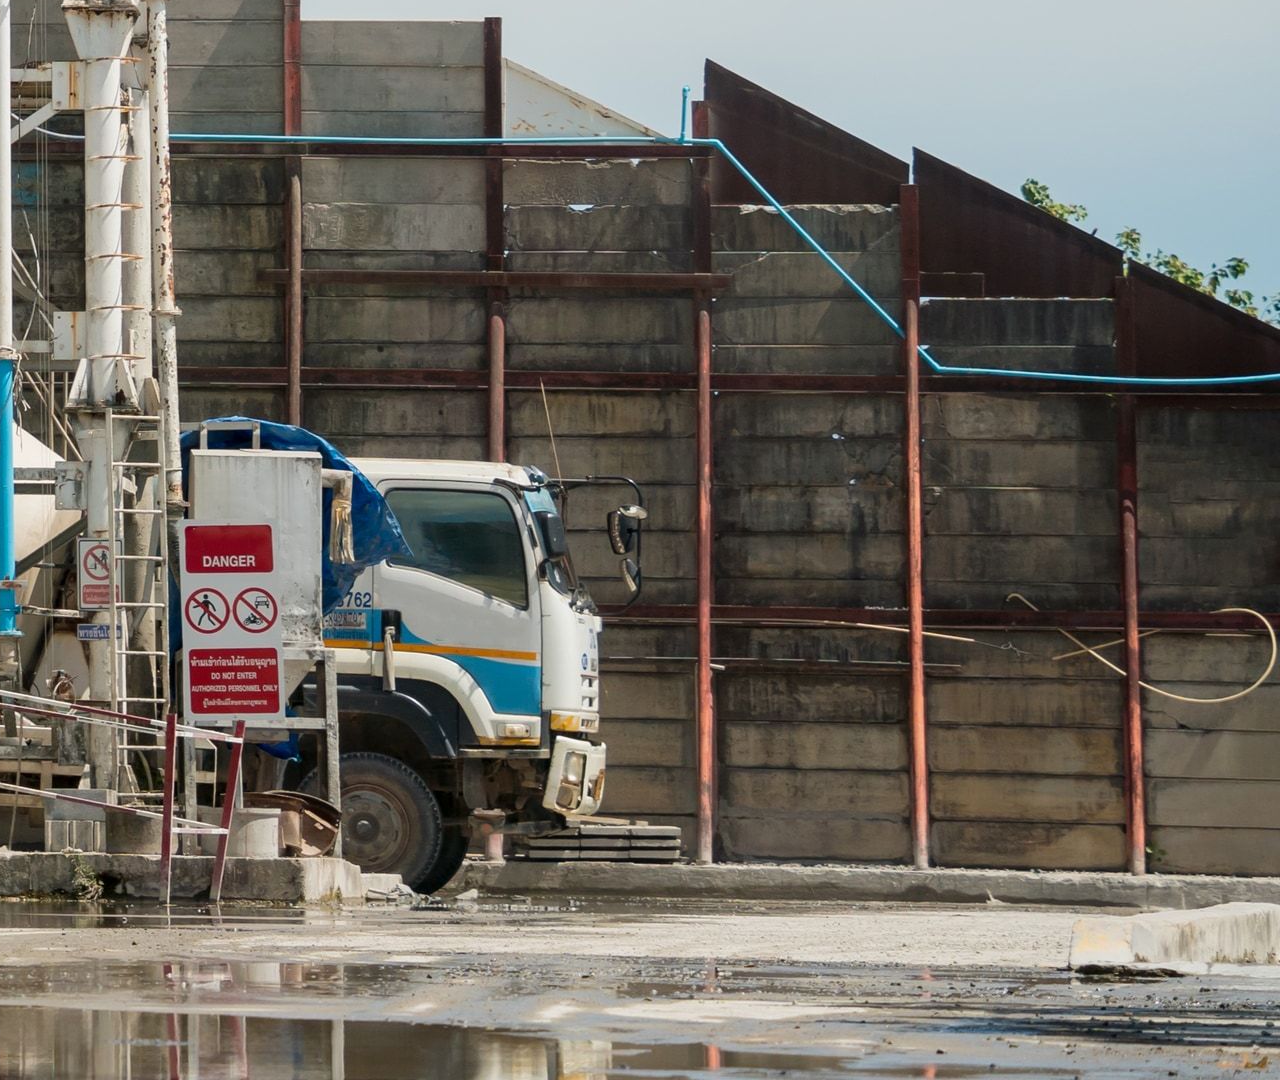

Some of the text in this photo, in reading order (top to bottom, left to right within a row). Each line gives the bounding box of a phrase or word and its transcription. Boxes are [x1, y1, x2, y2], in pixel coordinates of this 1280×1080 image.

[203, 555, 256, 568] DANGER
[211, 672, 257, 680] DO NOT ENTER
[192, 685, 227, 693] AUTHORIZED
[263, 684, 278, 692] ONLY
